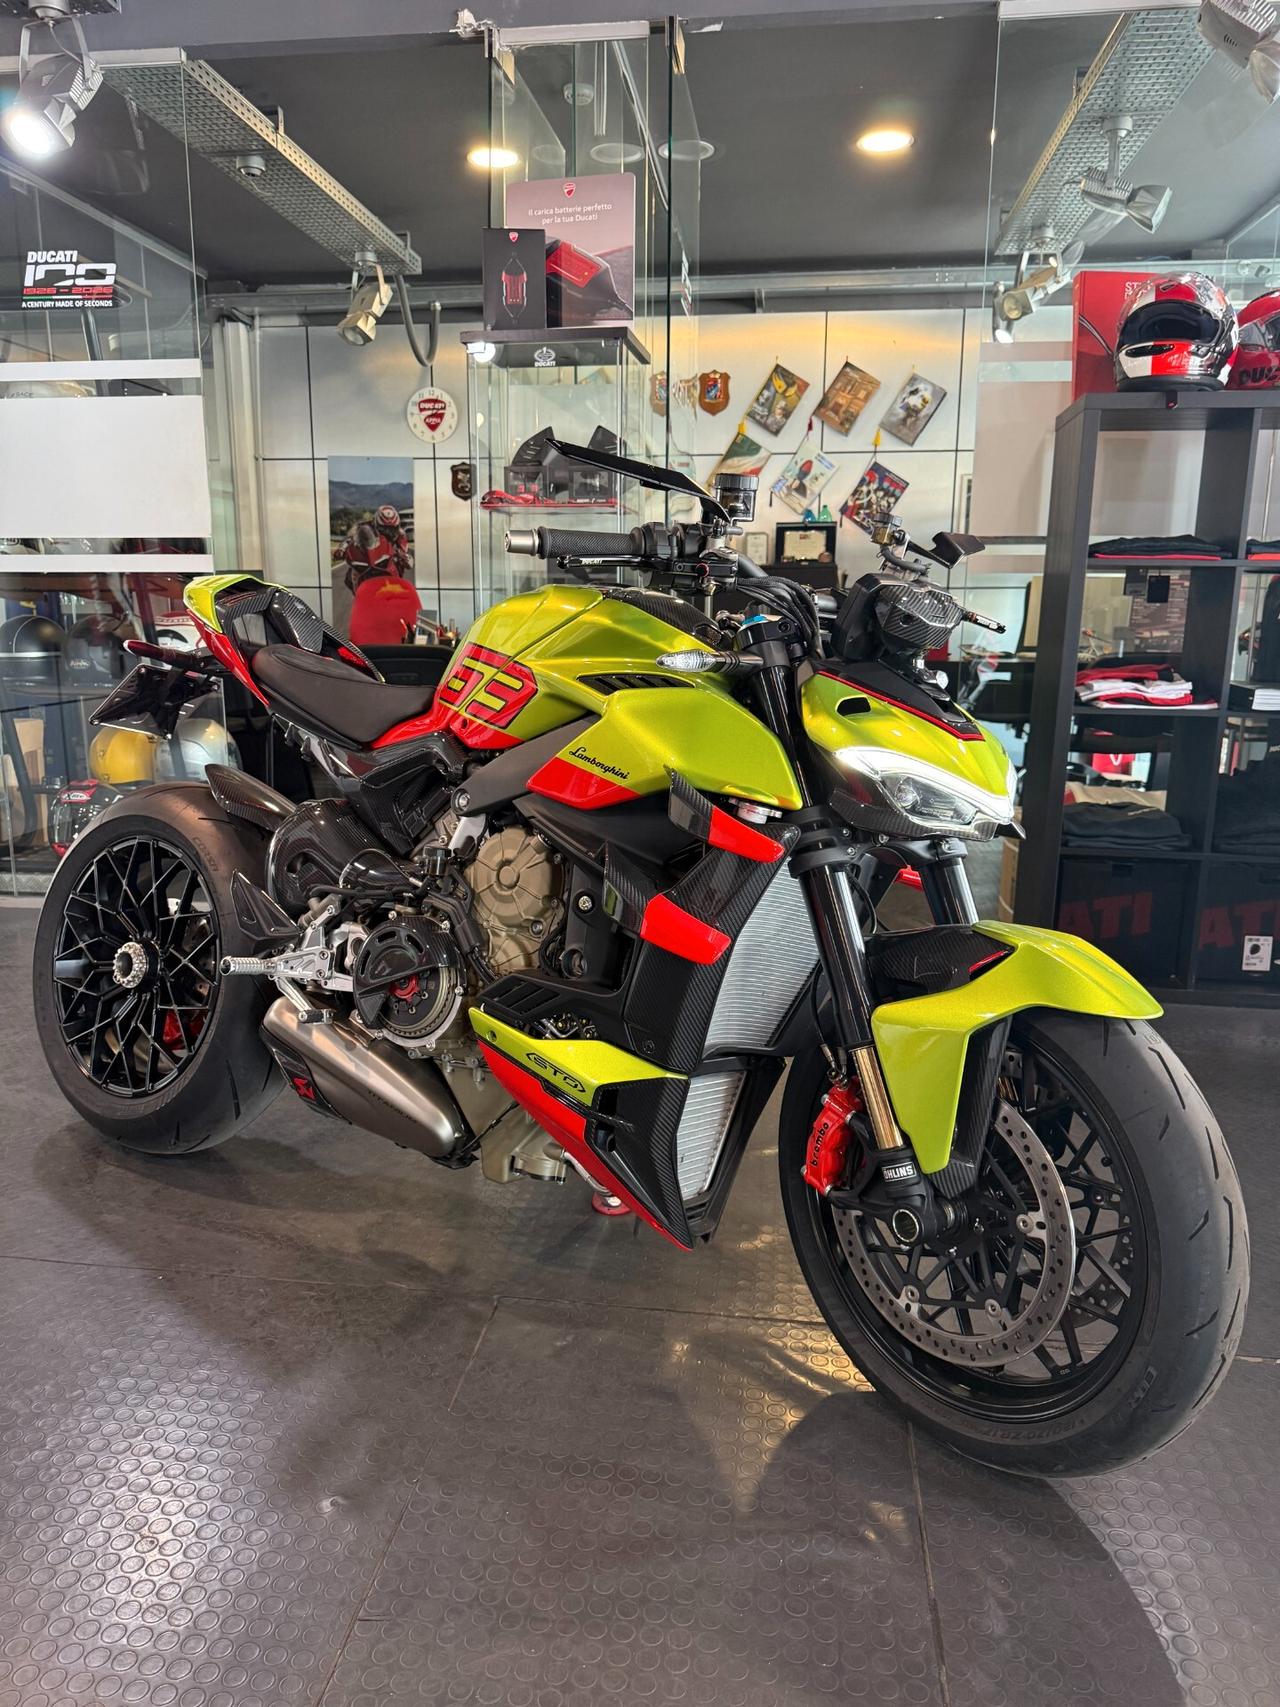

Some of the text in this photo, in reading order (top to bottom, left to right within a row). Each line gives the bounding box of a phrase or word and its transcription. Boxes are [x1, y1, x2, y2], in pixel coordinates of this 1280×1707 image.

[534, 207, 554, 216] carica
[555, 204, 581, 214] batterie
[583, 202, 612, 214] perfetto
[542, 217, 553, 225] per
[562, 215, 574, 223] tua
[575, 213, 598, 221] Ducati
[27, 250, 78, 263] DUCATI
[23, 287, 57, 295] 1926
[438, 641, 539, 730] 63
[568, 746, 630, 780] Lamborghini
[531, 1055, 580, 1089] STO
[810, 1121, 830, 1166] brembo
